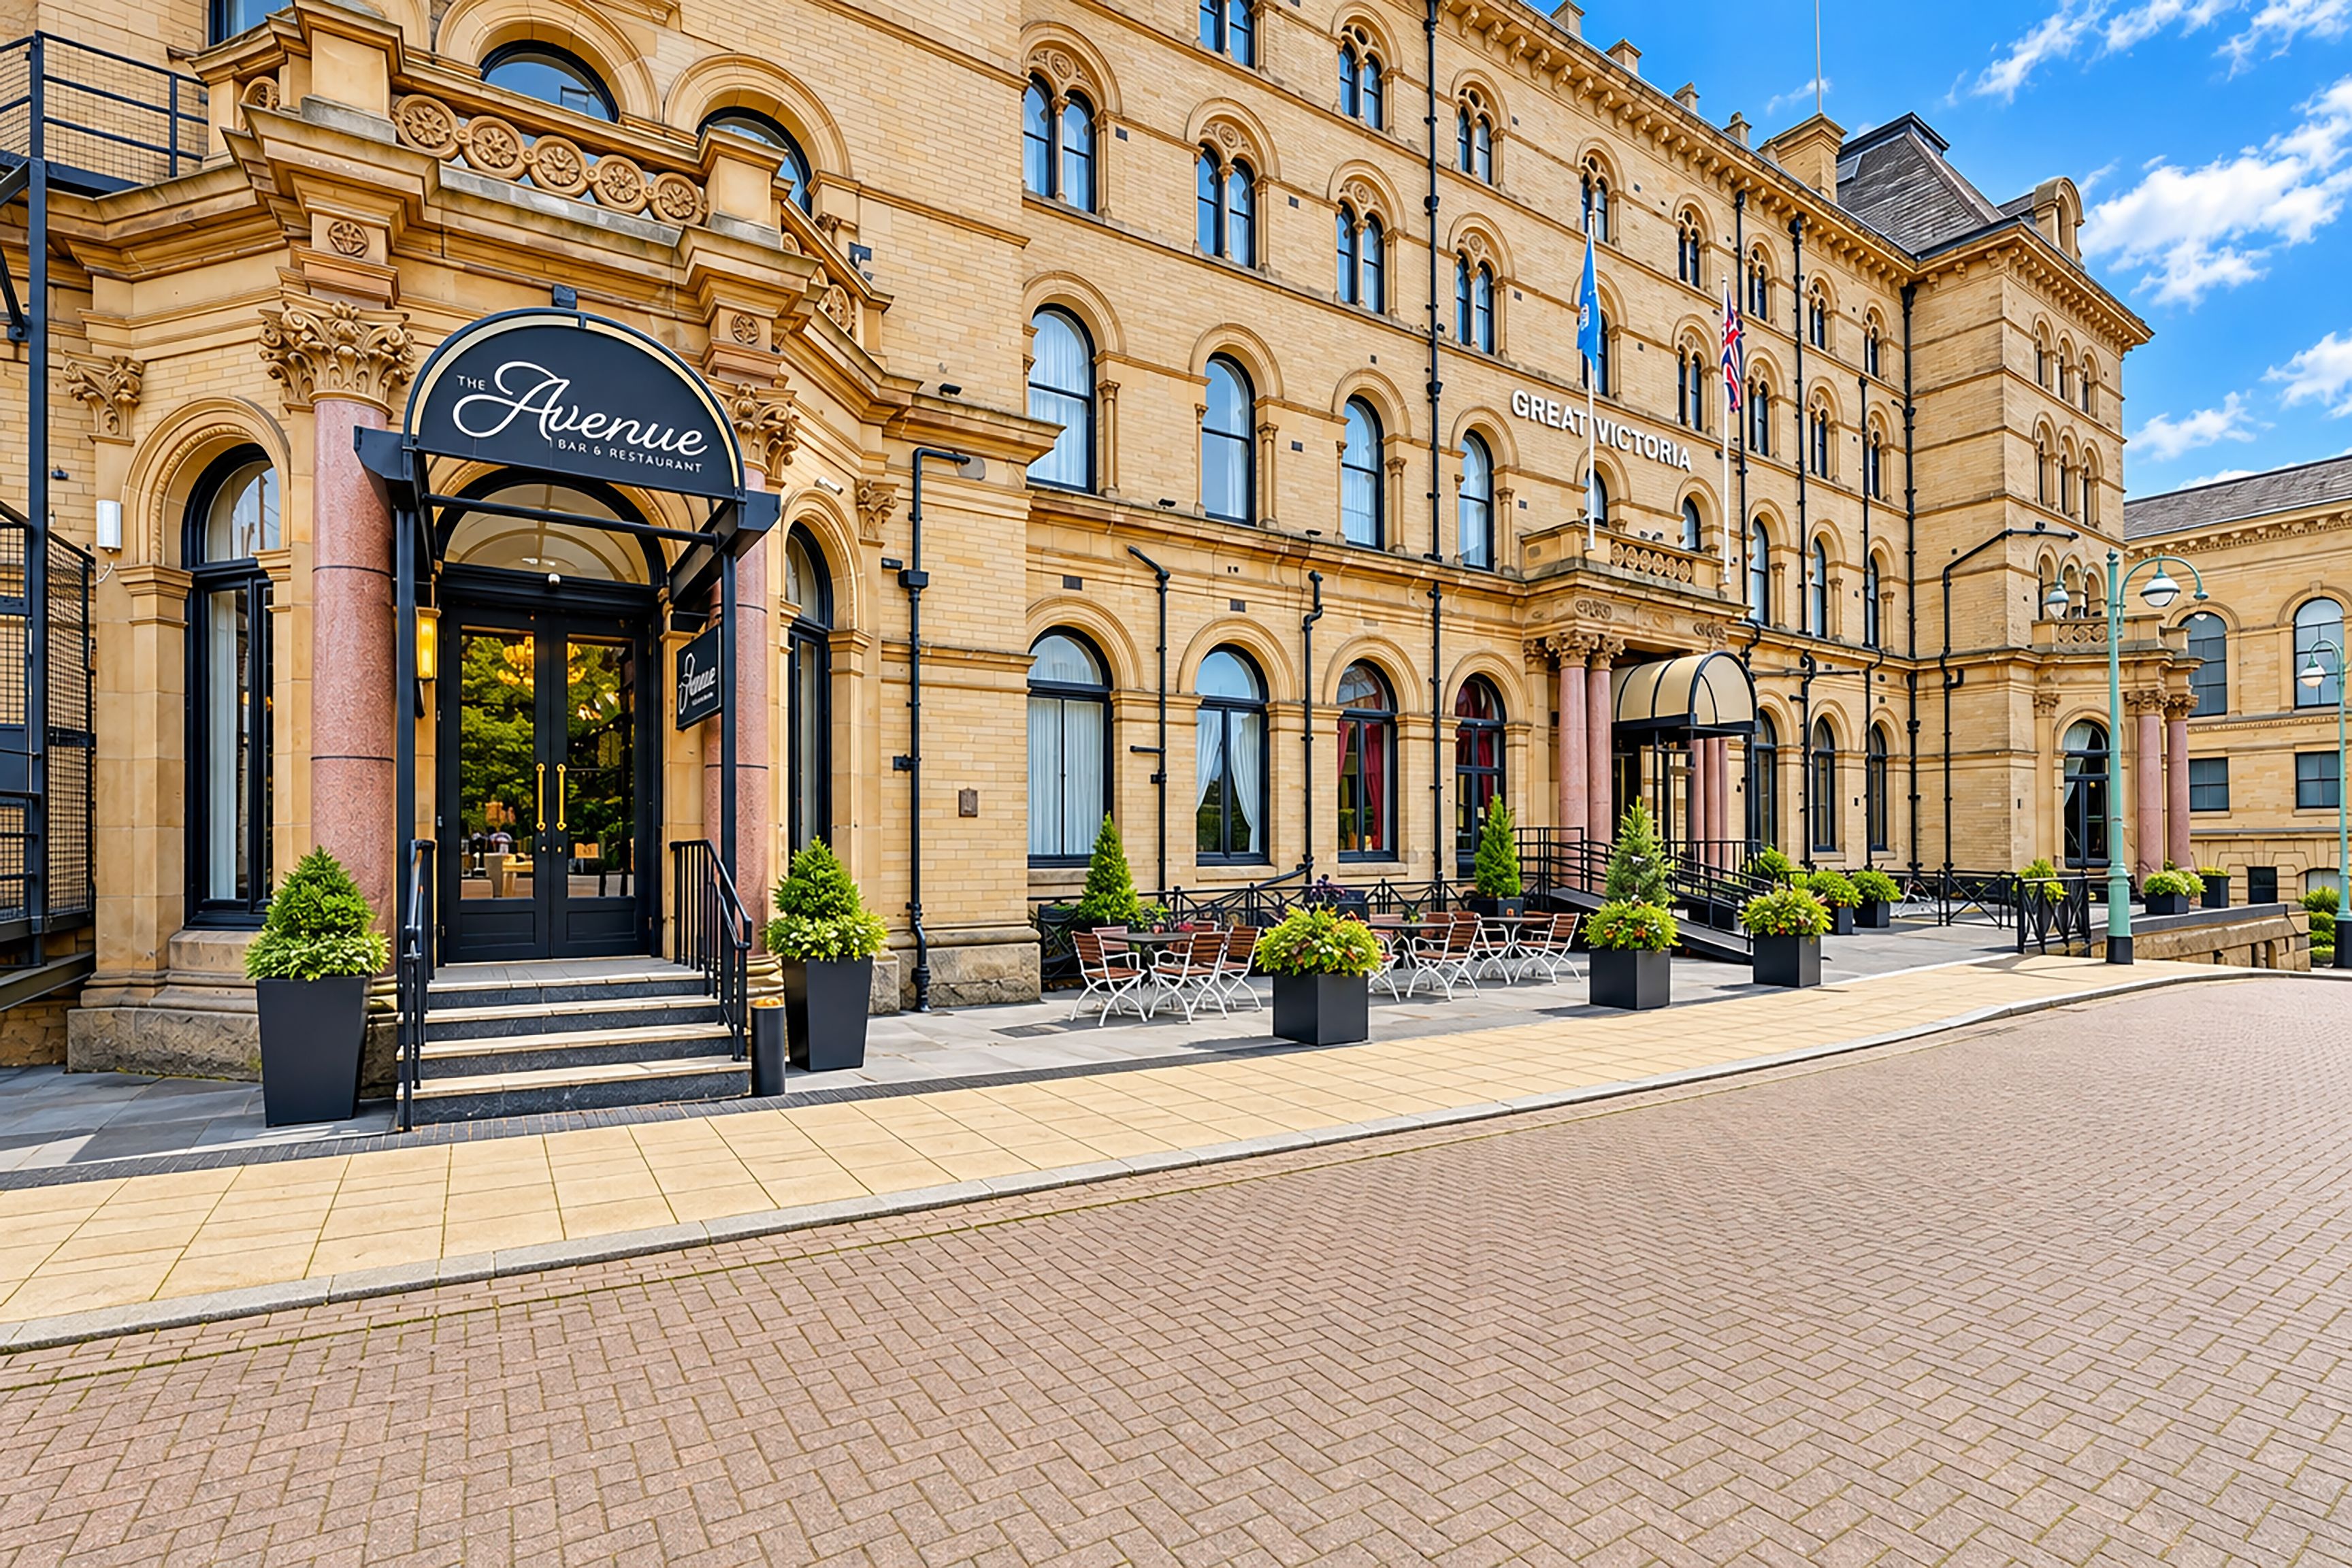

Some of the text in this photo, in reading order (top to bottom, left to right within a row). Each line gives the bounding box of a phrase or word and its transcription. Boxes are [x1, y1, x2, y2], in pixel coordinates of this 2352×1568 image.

[453, 361, 708, 456] Avenue
[457, 374, 486, 391] THE
[558, 439, 702, 473] BAR & RESTAURANT
[1512, 389, 1691, 472] GREAT VICTORIA
